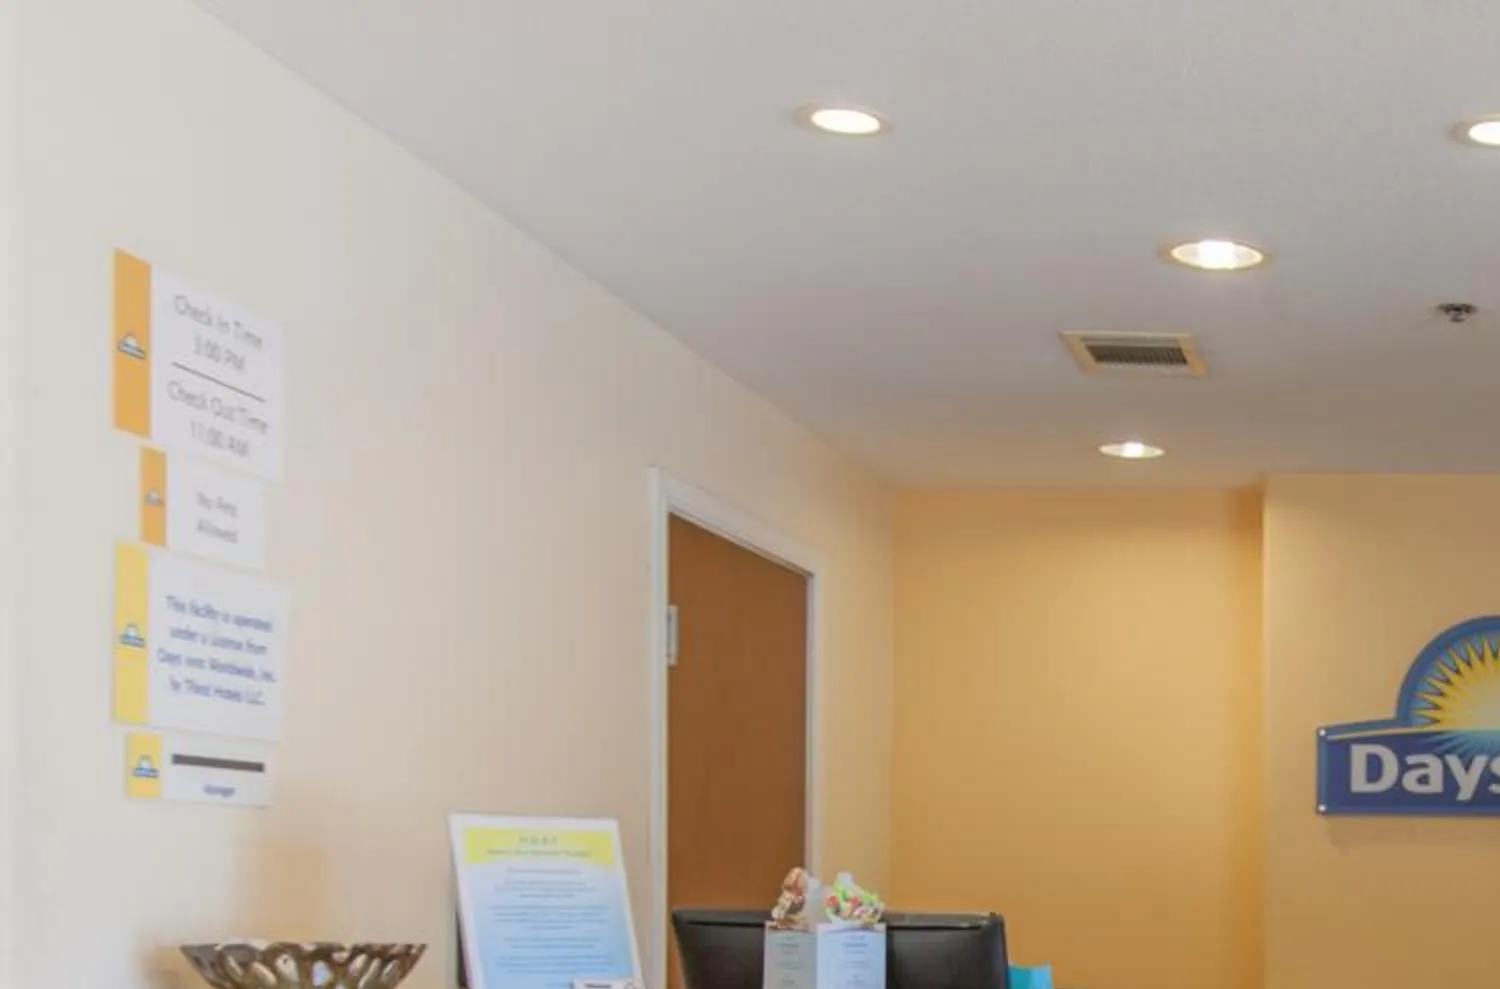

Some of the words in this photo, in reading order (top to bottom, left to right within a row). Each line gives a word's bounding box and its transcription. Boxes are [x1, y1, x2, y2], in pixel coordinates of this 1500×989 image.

[173, 294, 213, 327] Check
[233, 319, 263, 350] Time
[165, 379, 207, 410] Check
[237, 405, 268, 434] Time
